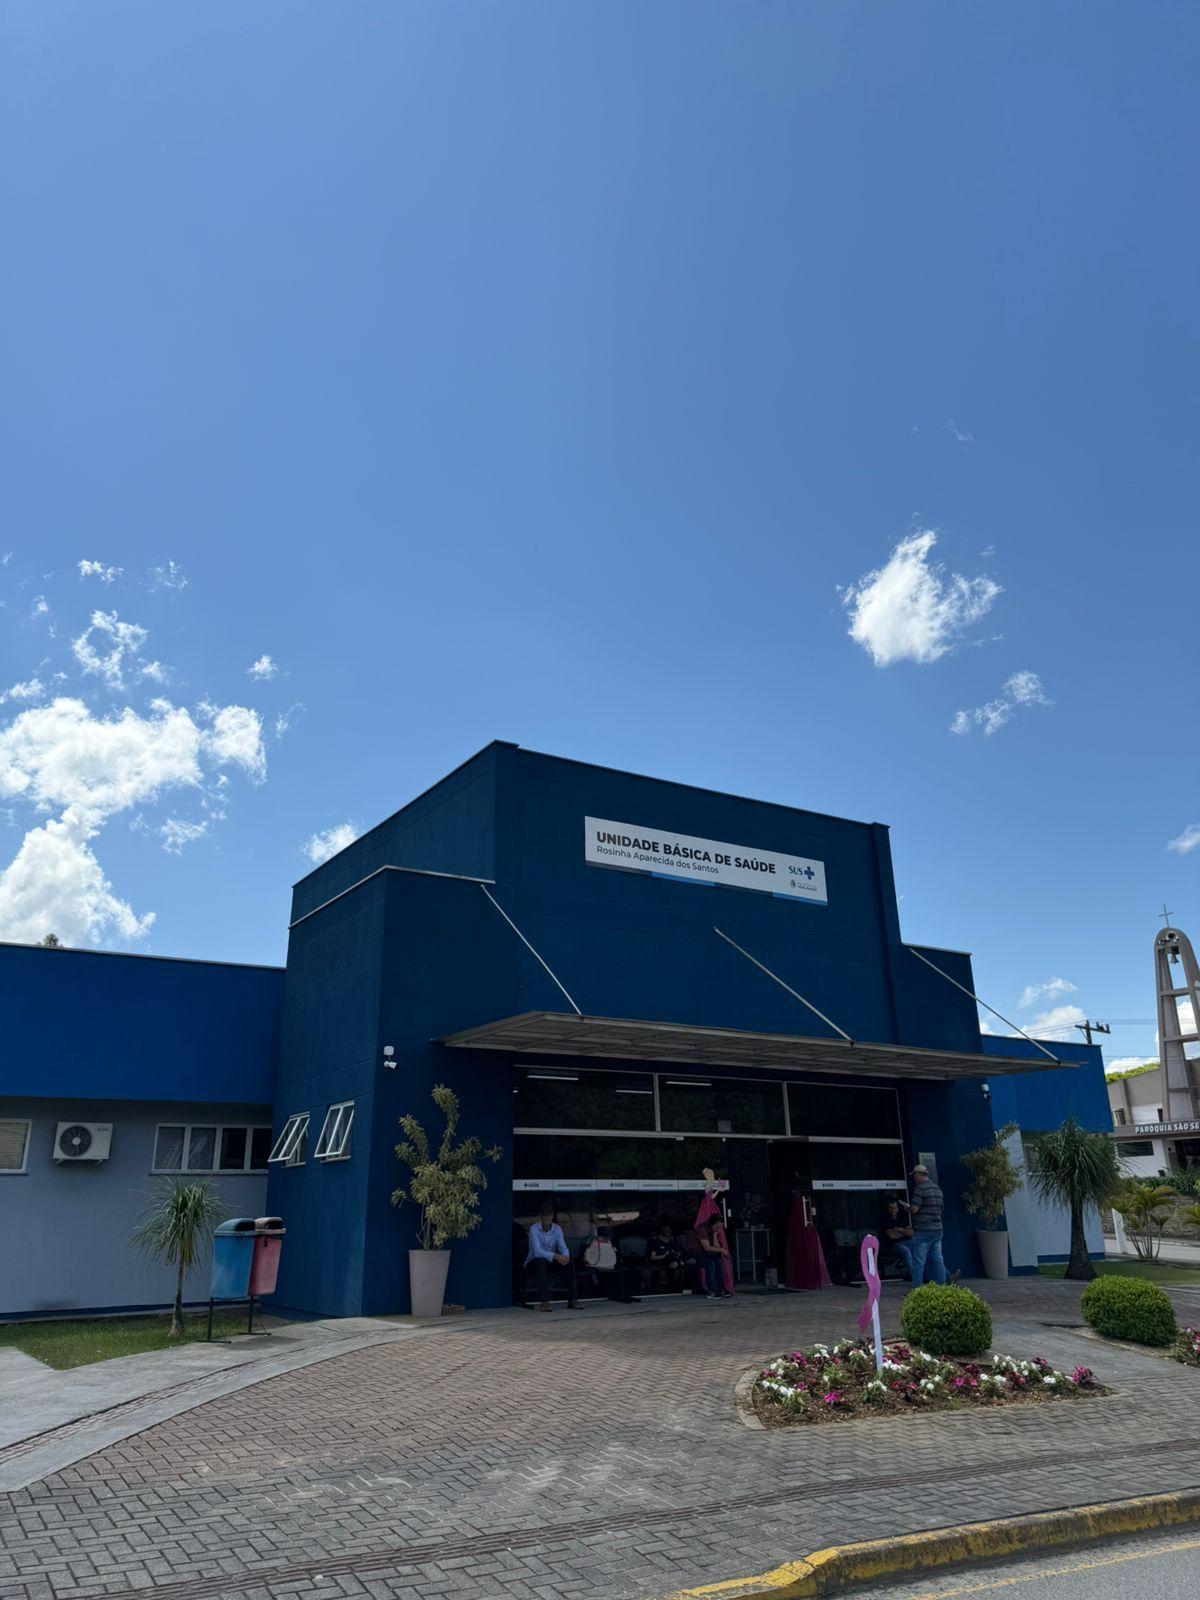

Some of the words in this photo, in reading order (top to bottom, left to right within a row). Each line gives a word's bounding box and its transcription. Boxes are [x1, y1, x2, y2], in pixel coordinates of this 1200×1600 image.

[596, 831, 660, 853] UNIDADE
[663, 843, 712, 862] BÁSICA
[714, 853, 731, 866] DE
[734, 857, 776, 874] SAÚDE
[596, 845, 631, 859] Rosinha
[633, 852, 675, 866] Aparecida
[676, 860, 691, 869] dos
[692, 862, 719, 874] Santos
[788, 865, 803, 876] SUS
